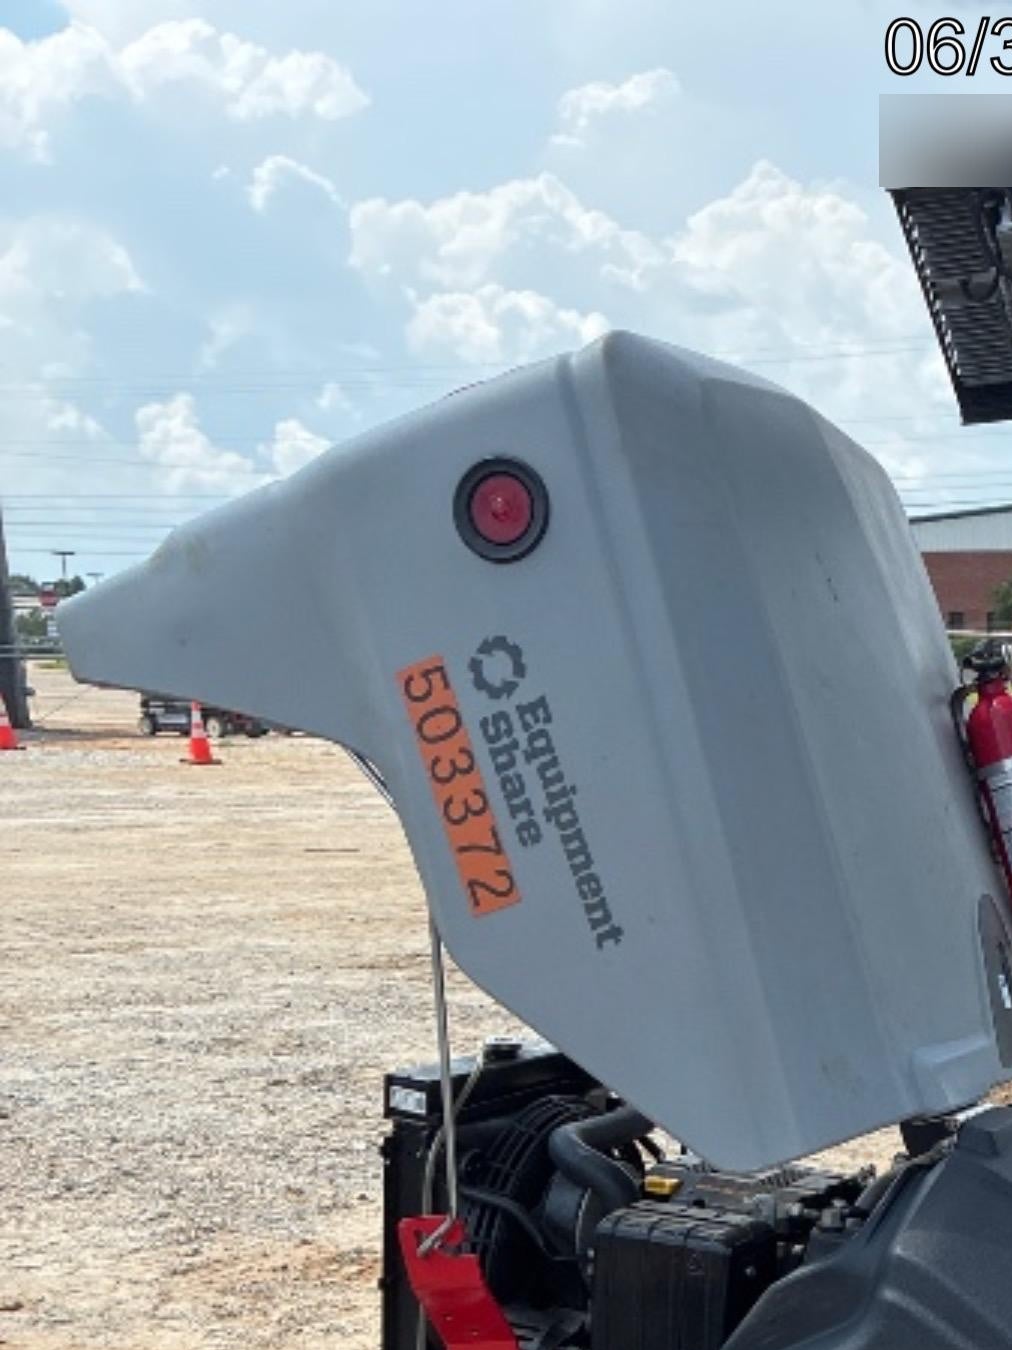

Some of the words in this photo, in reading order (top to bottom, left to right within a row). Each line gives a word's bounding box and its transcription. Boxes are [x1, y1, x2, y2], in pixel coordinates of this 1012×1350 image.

[404, 664, 516, 908] 503372
[480, 712, 543, 847] Share
[516, 695, 624, 950] Equipment
